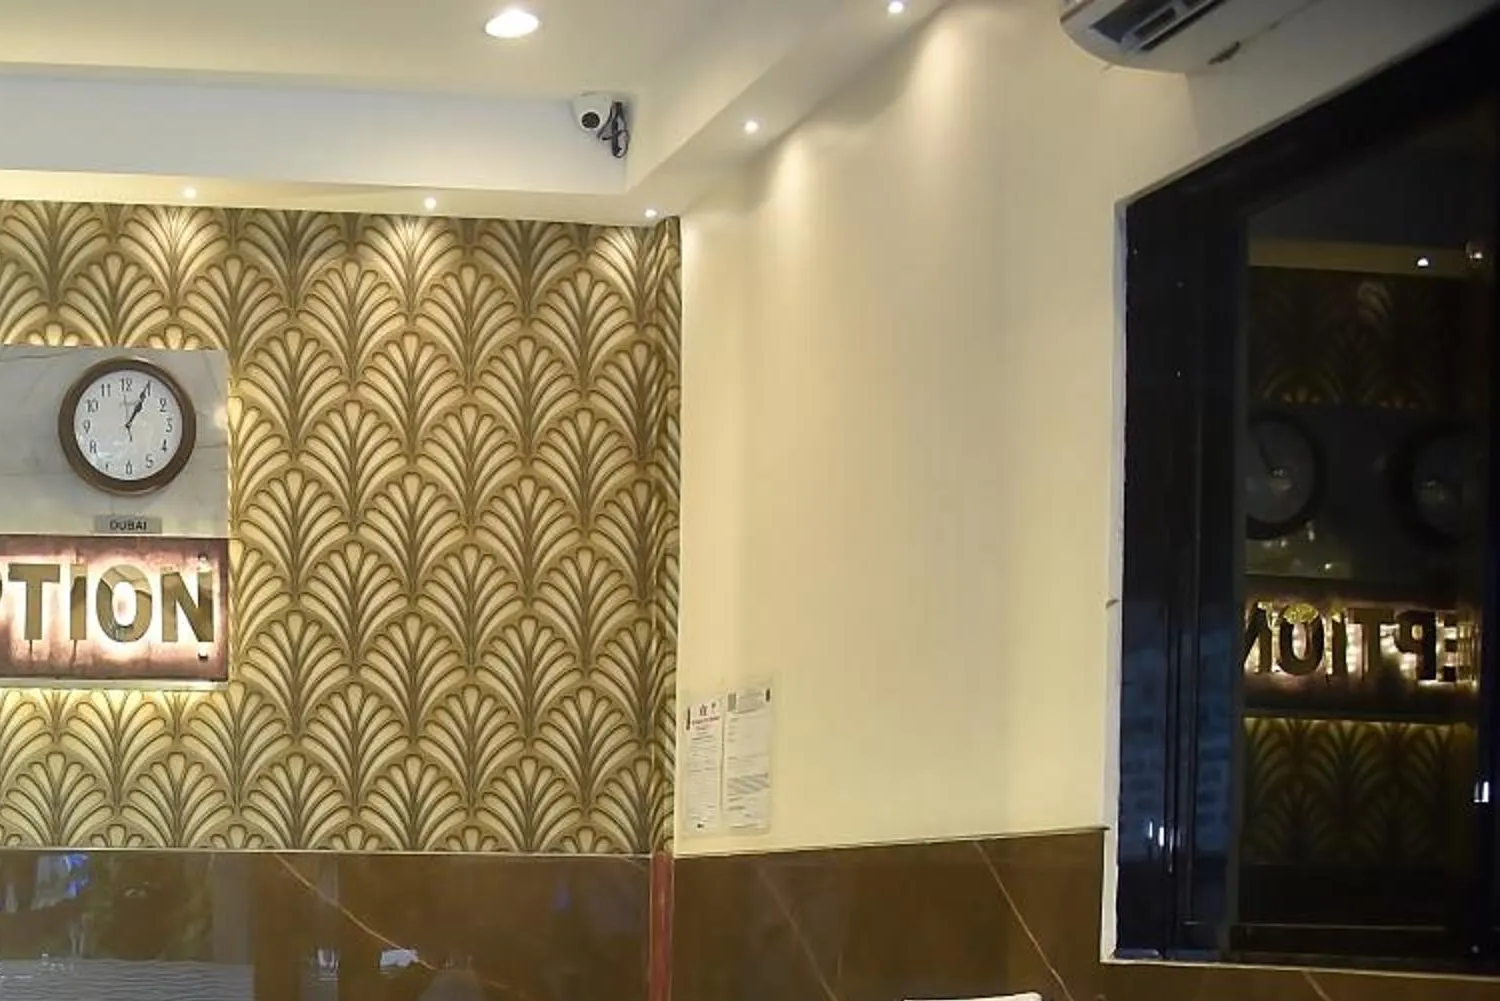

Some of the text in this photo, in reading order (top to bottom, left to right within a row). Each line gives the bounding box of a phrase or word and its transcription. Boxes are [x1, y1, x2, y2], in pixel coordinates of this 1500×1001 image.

[101, 383, 111, 397] 11
[121, 378, 133, 392] 12
[86, 399, 99, 413] 10
[159, 398, 167, 413] 2
[165, 418, 173, 433] 3
[145, 454, 154, 469] 5
[110, 520, 147, 530] DUBAI
